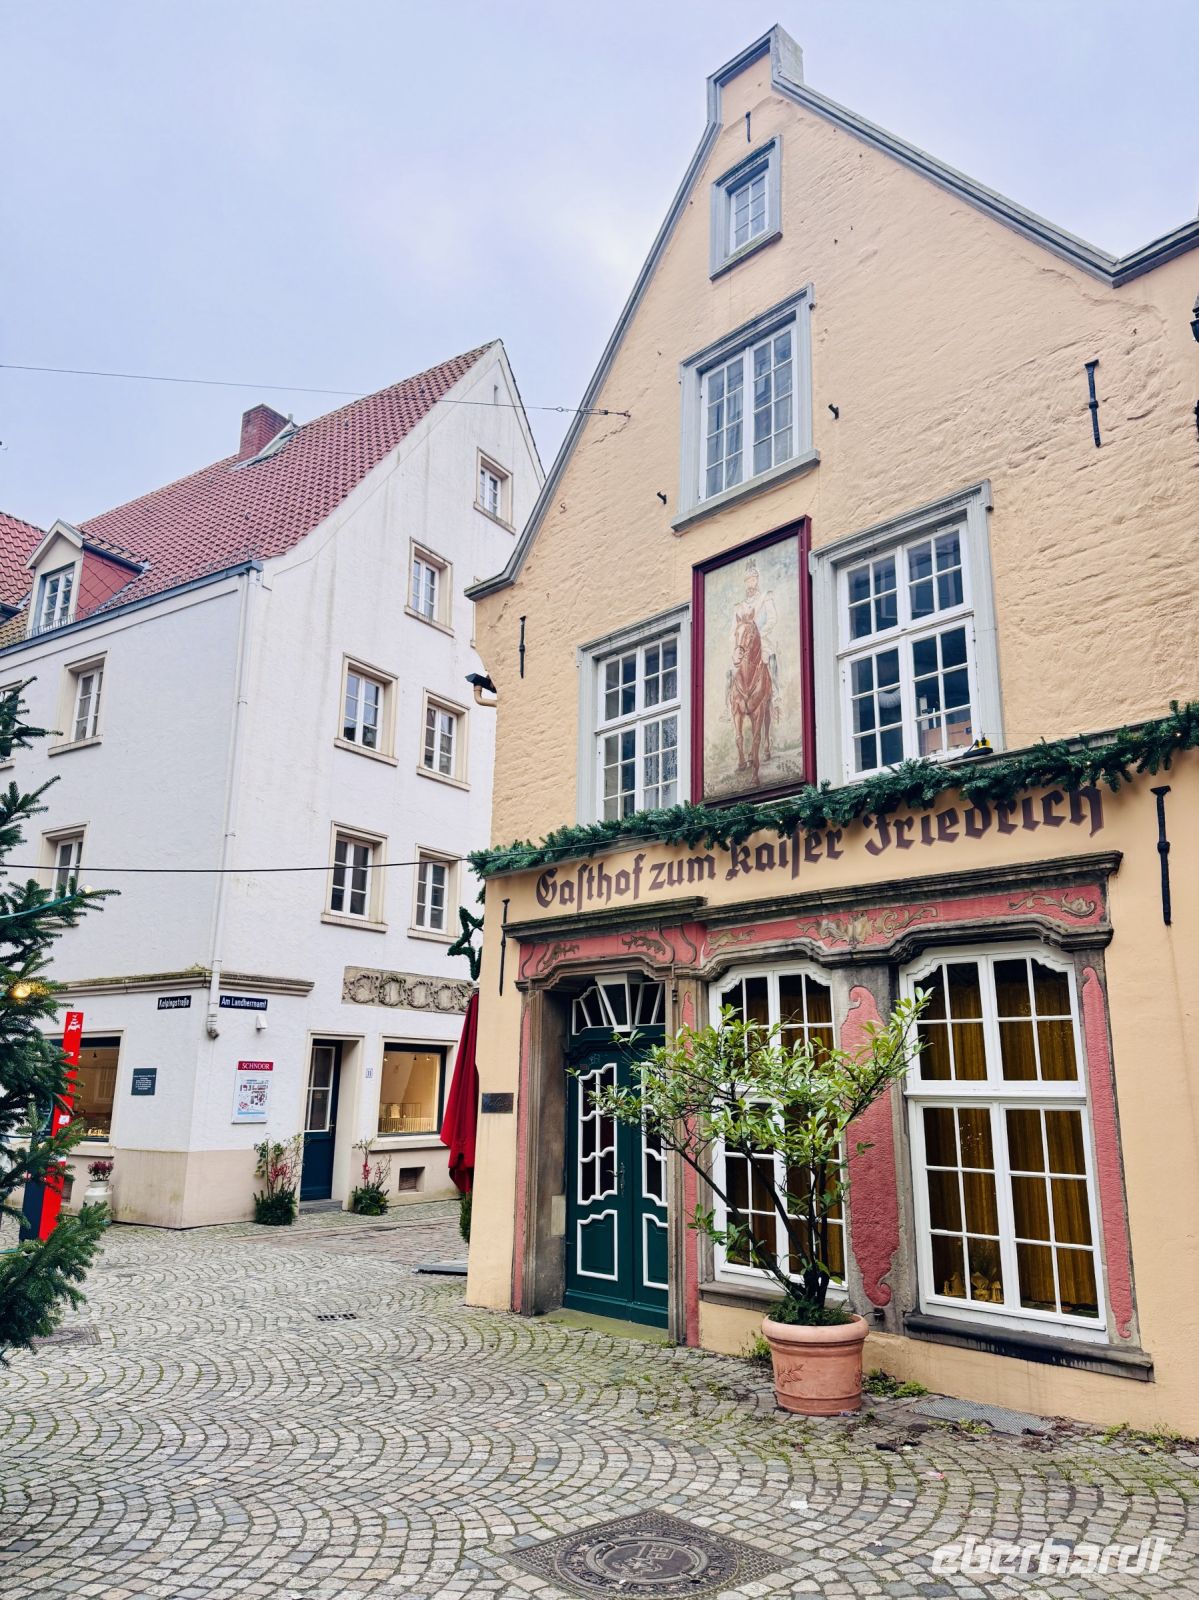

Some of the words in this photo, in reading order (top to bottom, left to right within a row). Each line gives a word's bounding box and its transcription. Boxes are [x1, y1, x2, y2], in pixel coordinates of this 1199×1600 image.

[648, 852, 716, 891] zum
[863, 784, 1105, 856] Friedrich
[221, 997, 231, 1006] Am
[231, 999, 267, 1009] Landherrnamt
[241, 1062, 270, 1070] SCHNOOR
